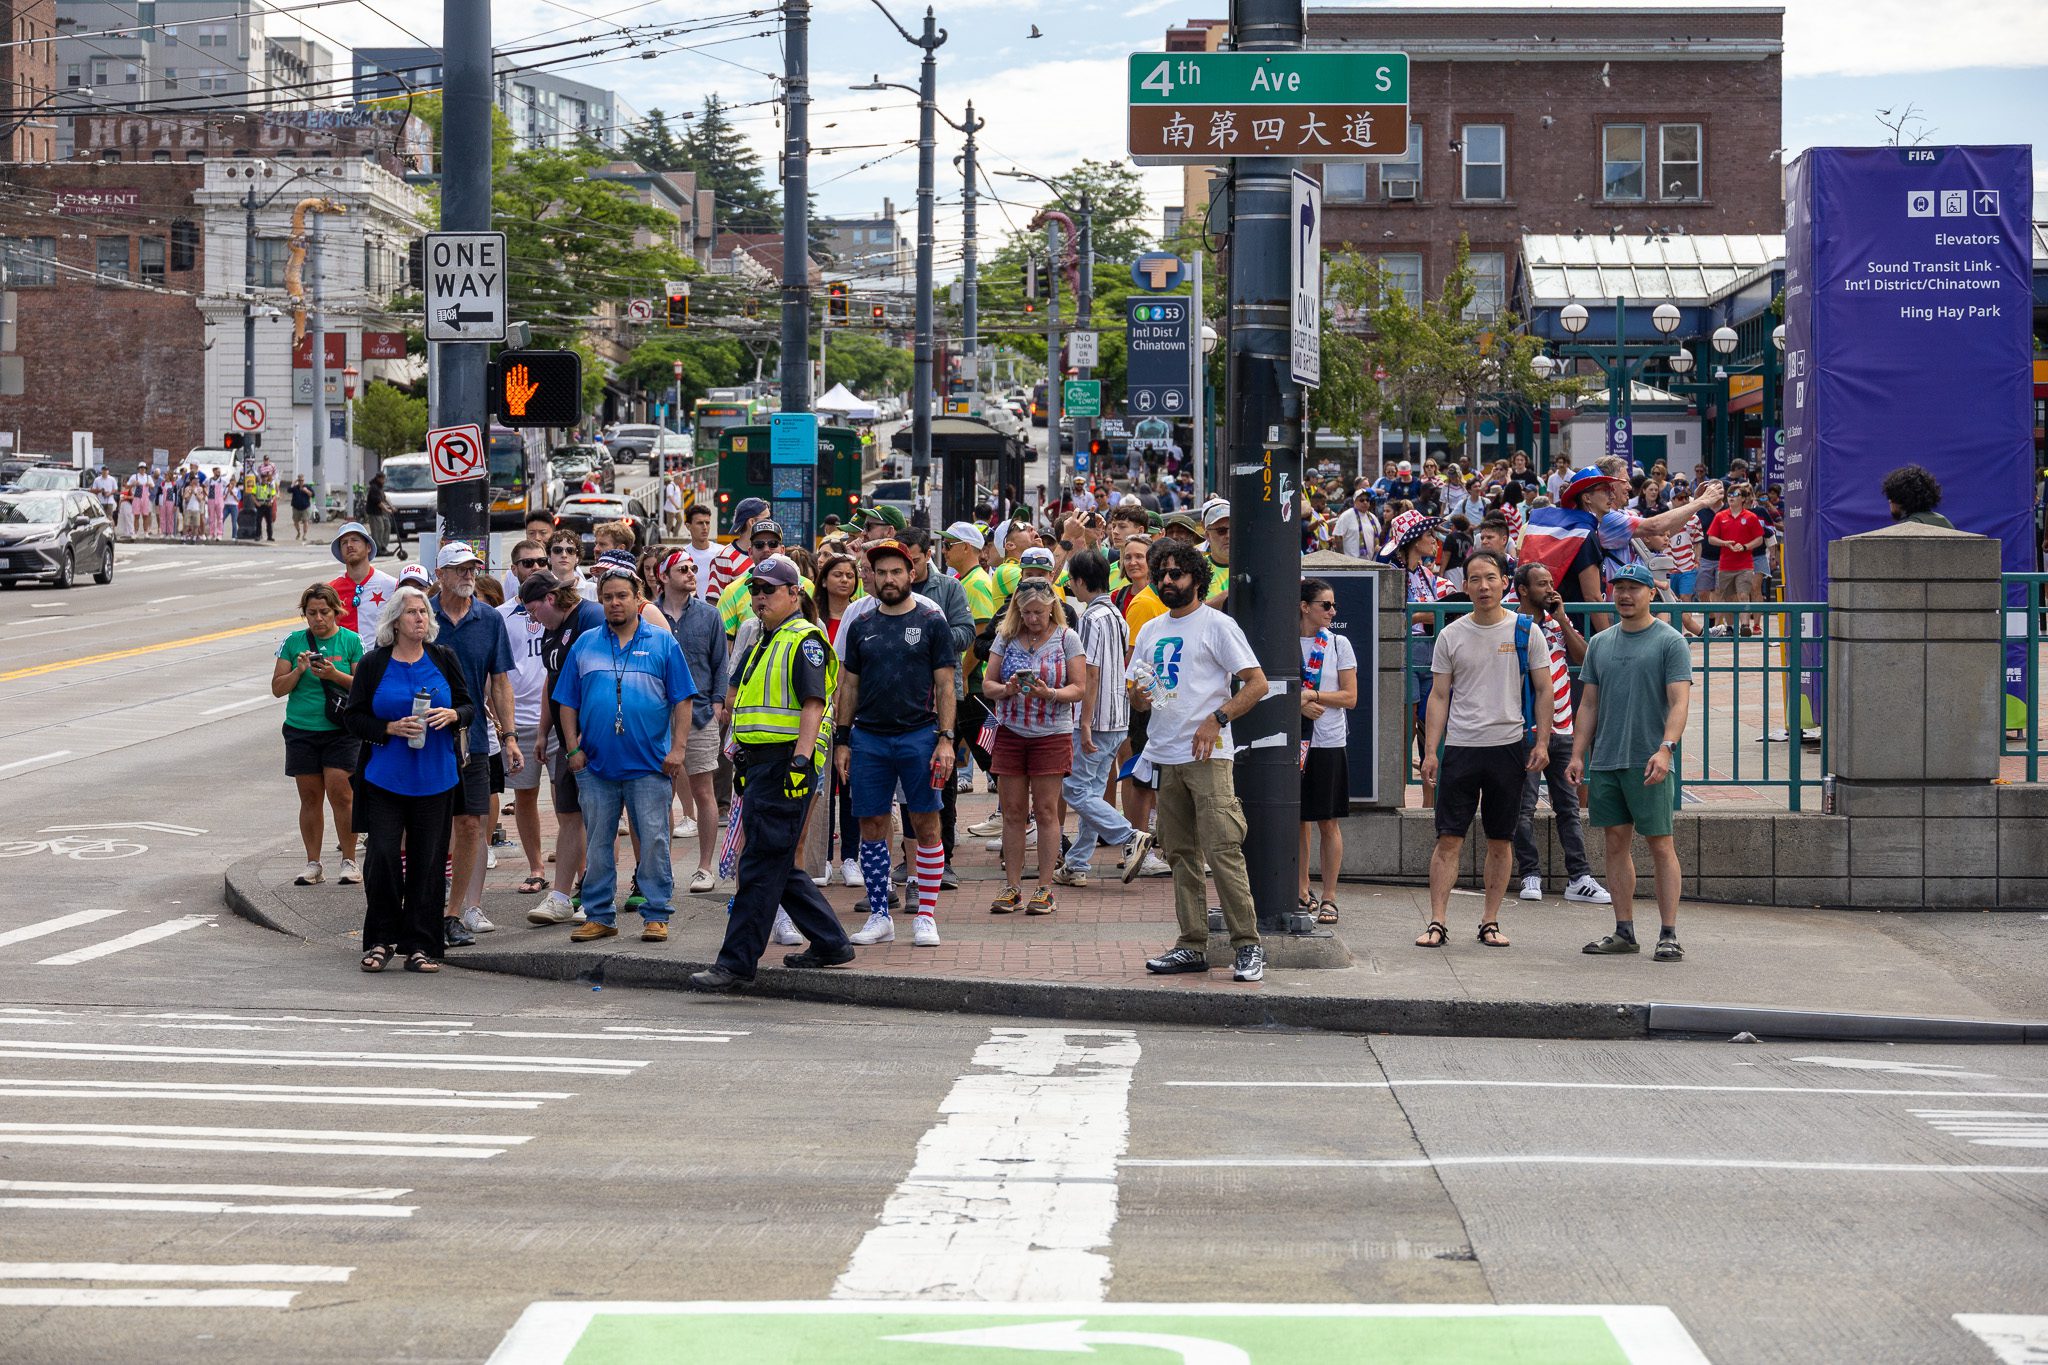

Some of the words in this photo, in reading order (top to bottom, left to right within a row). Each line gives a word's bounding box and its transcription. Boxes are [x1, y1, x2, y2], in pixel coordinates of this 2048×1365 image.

[1141, 60, 1201, 97] 4th
[1250, 67, 1301, 91] Ave
[1374, 67, 1392, 92] S
[89, 117, 235, 147] HOTEL
[1162, 110, 1378, 149] 南第四大道
[1908, 150, 1936, 161] FIFA
[1935, 233, 2001, 246] Elevators
[433, 242, 496, 268] ONE
[1867, 260, 1910, 273] Sound
[1912, 260, 1961, 273] Transit
[1963, 260, 1993, 273] Link
[434, 273, 498, 298] WAY
[1874, 278, 2001, 291] District/Chinatown
[1165, 308, 1180, 319] 53
[1297, 291, 1316, 330] ONLY
[1900, 306, 1934, 321] Hing
[1937, 305, 1965, 321] Hay
[1968, 304, 2001, 318] Park
[1077, 334, 1091, 342] NO
[1132, 327, 1150, 338] Intl
[1153, 327, 1173, 338] Dist
[1175, 327, 1180, 338] /
[1075, 342, 1093, 350] TURN
[1132, 339, 1186, 351] Chinatown
[1263, 450, 1273, 502] 402
[1769, 472, 1785, 480] Stati
[1675, 534, 1683, 547] 8
[403, 565, 421, 575] USA
